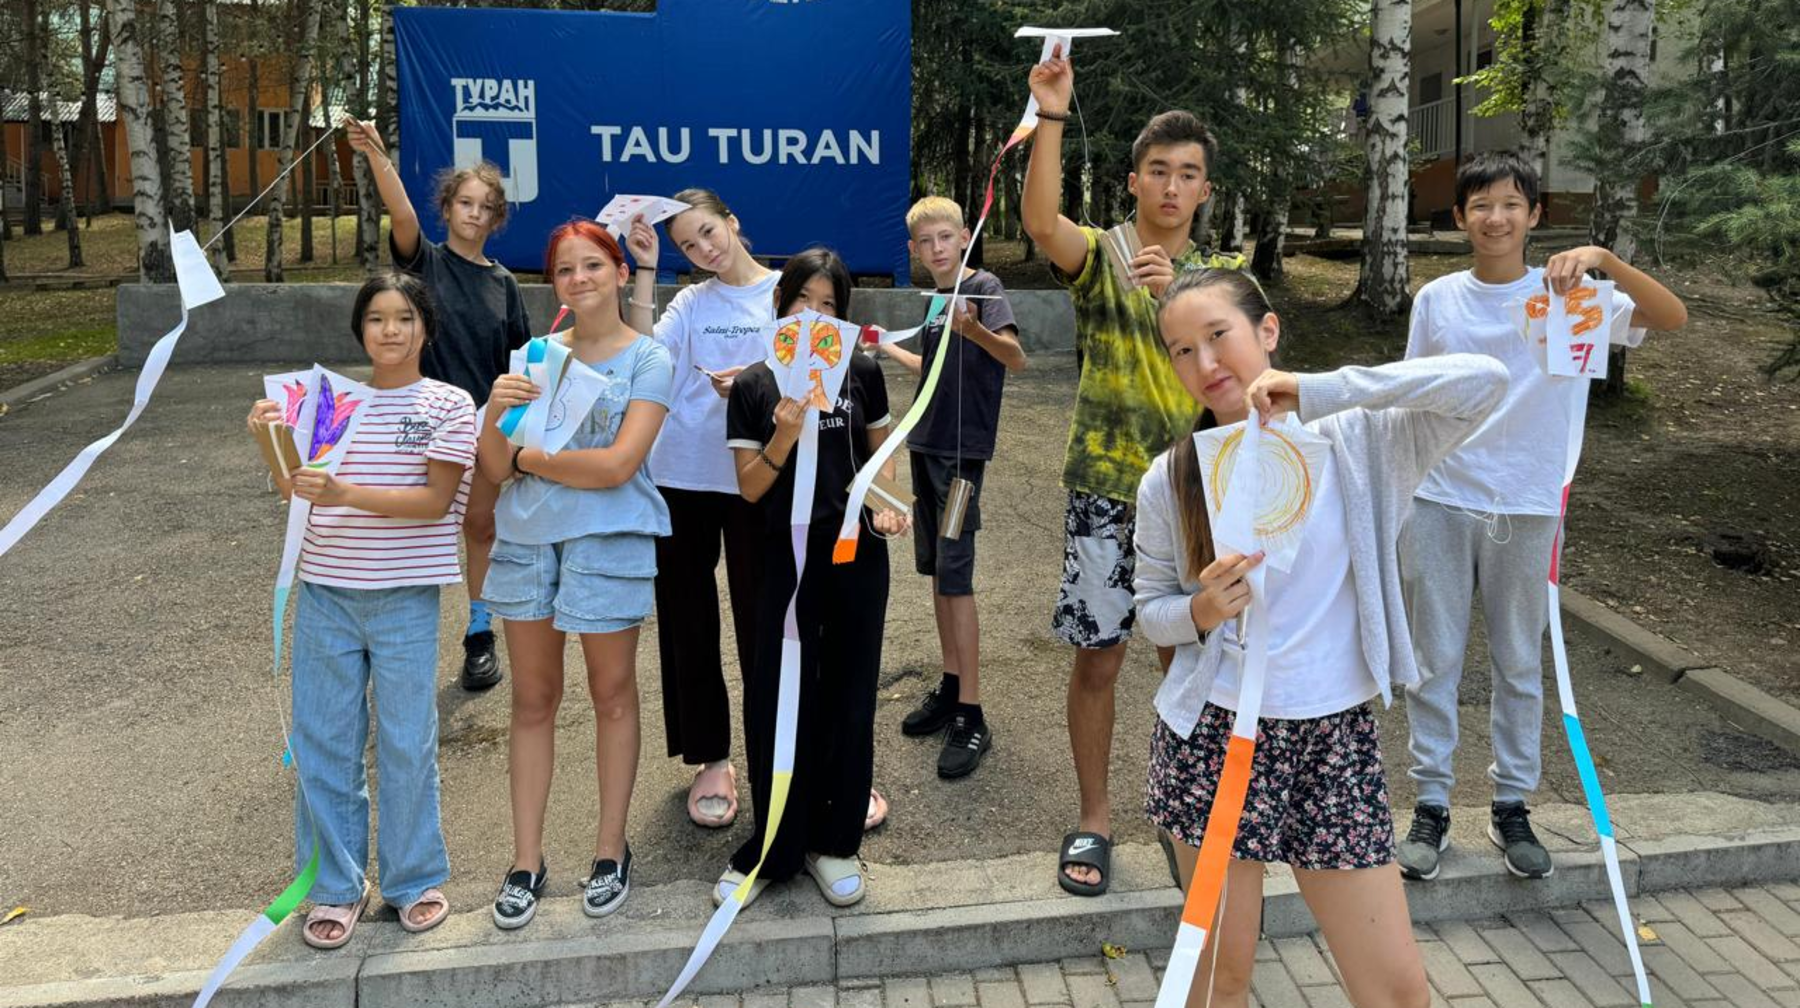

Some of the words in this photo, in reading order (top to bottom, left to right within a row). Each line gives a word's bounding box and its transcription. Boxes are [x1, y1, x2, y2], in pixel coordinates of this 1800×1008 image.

[450, 78, 536, 116] ТУРАН
[590, 126, 691, 163] TAU
[708, 128, 880, 165] TURAN
